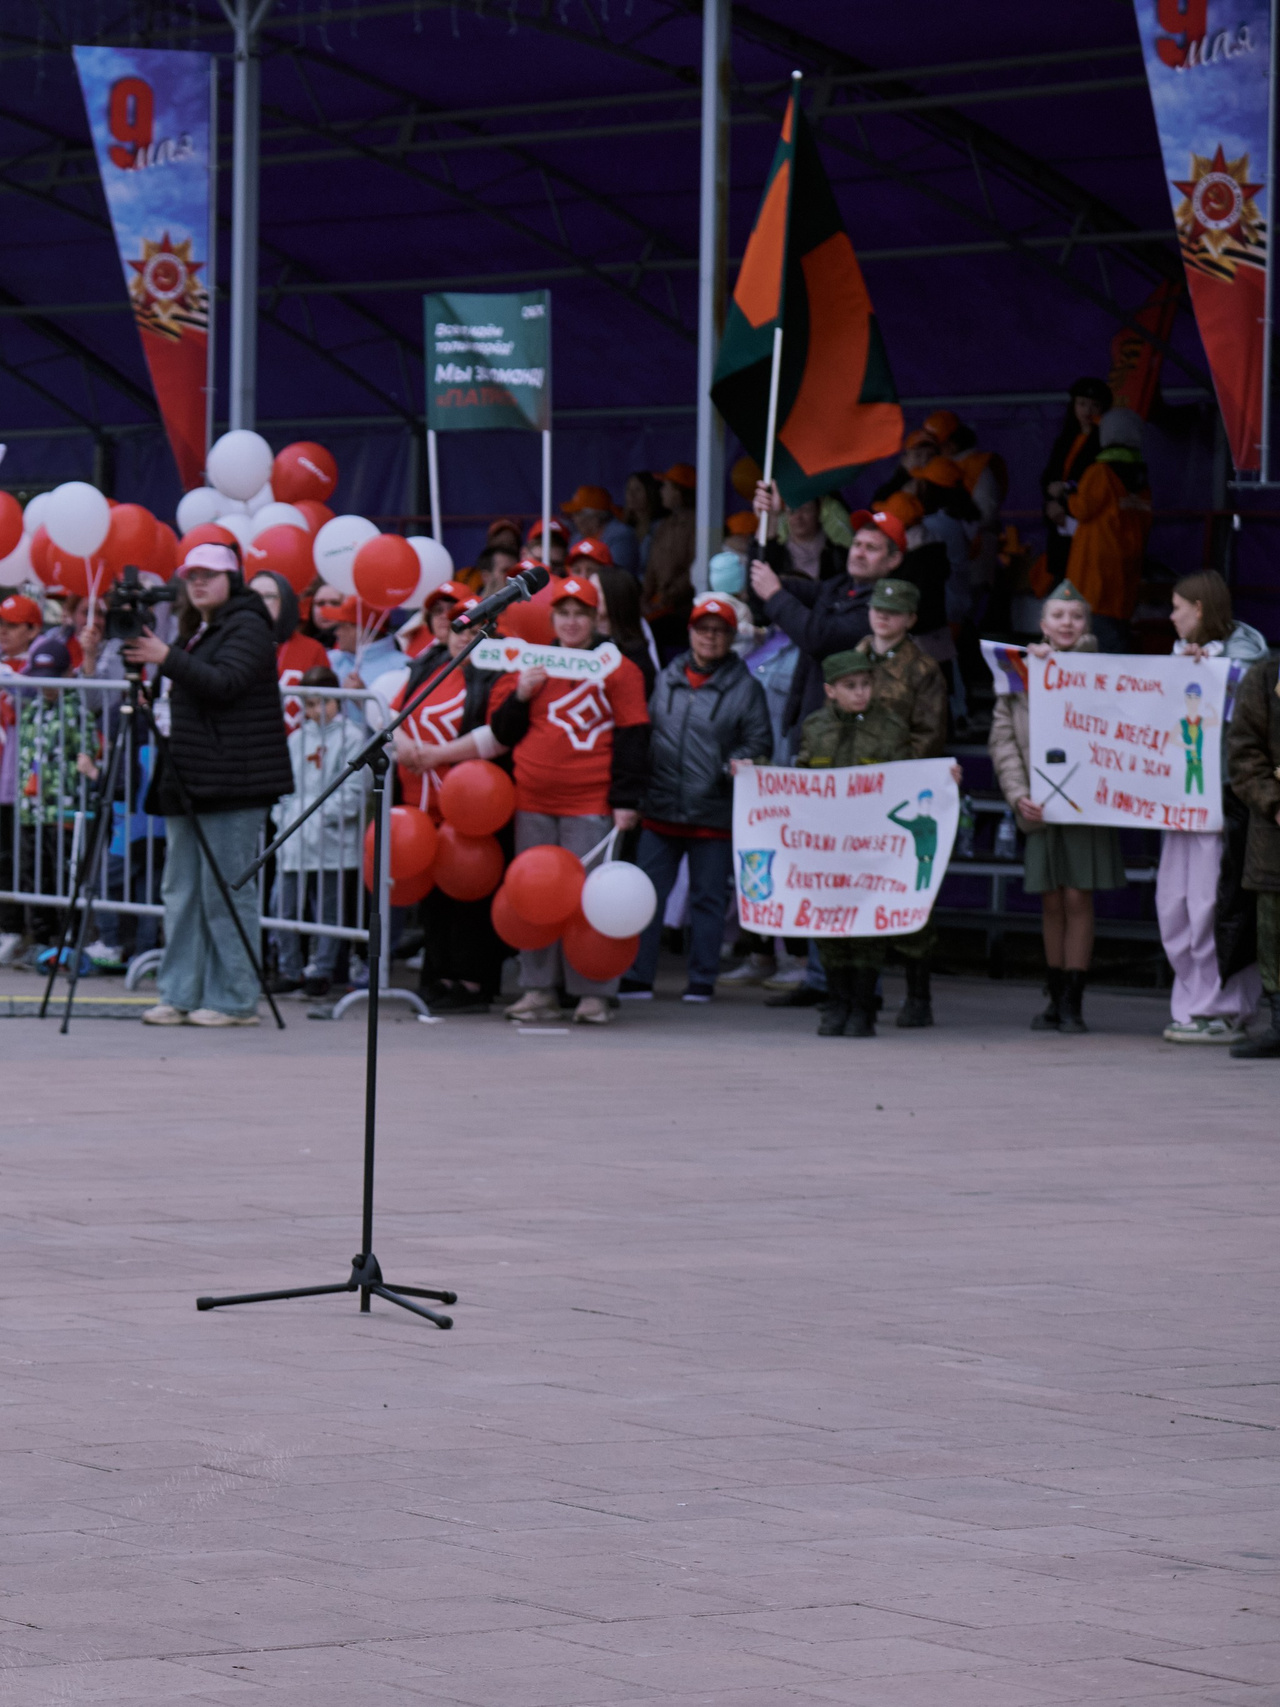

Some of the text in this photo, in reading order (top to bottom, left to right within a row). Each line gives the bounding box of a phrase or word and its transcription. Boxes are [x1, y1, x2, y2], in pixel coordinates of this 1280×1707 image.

[1157, 0, 1207, 69] 9
[109, 77, 154, 170] 9
[434, 363, 472, 384] Мы
[479, 648, 601, 673] #Я СИБАГРО
